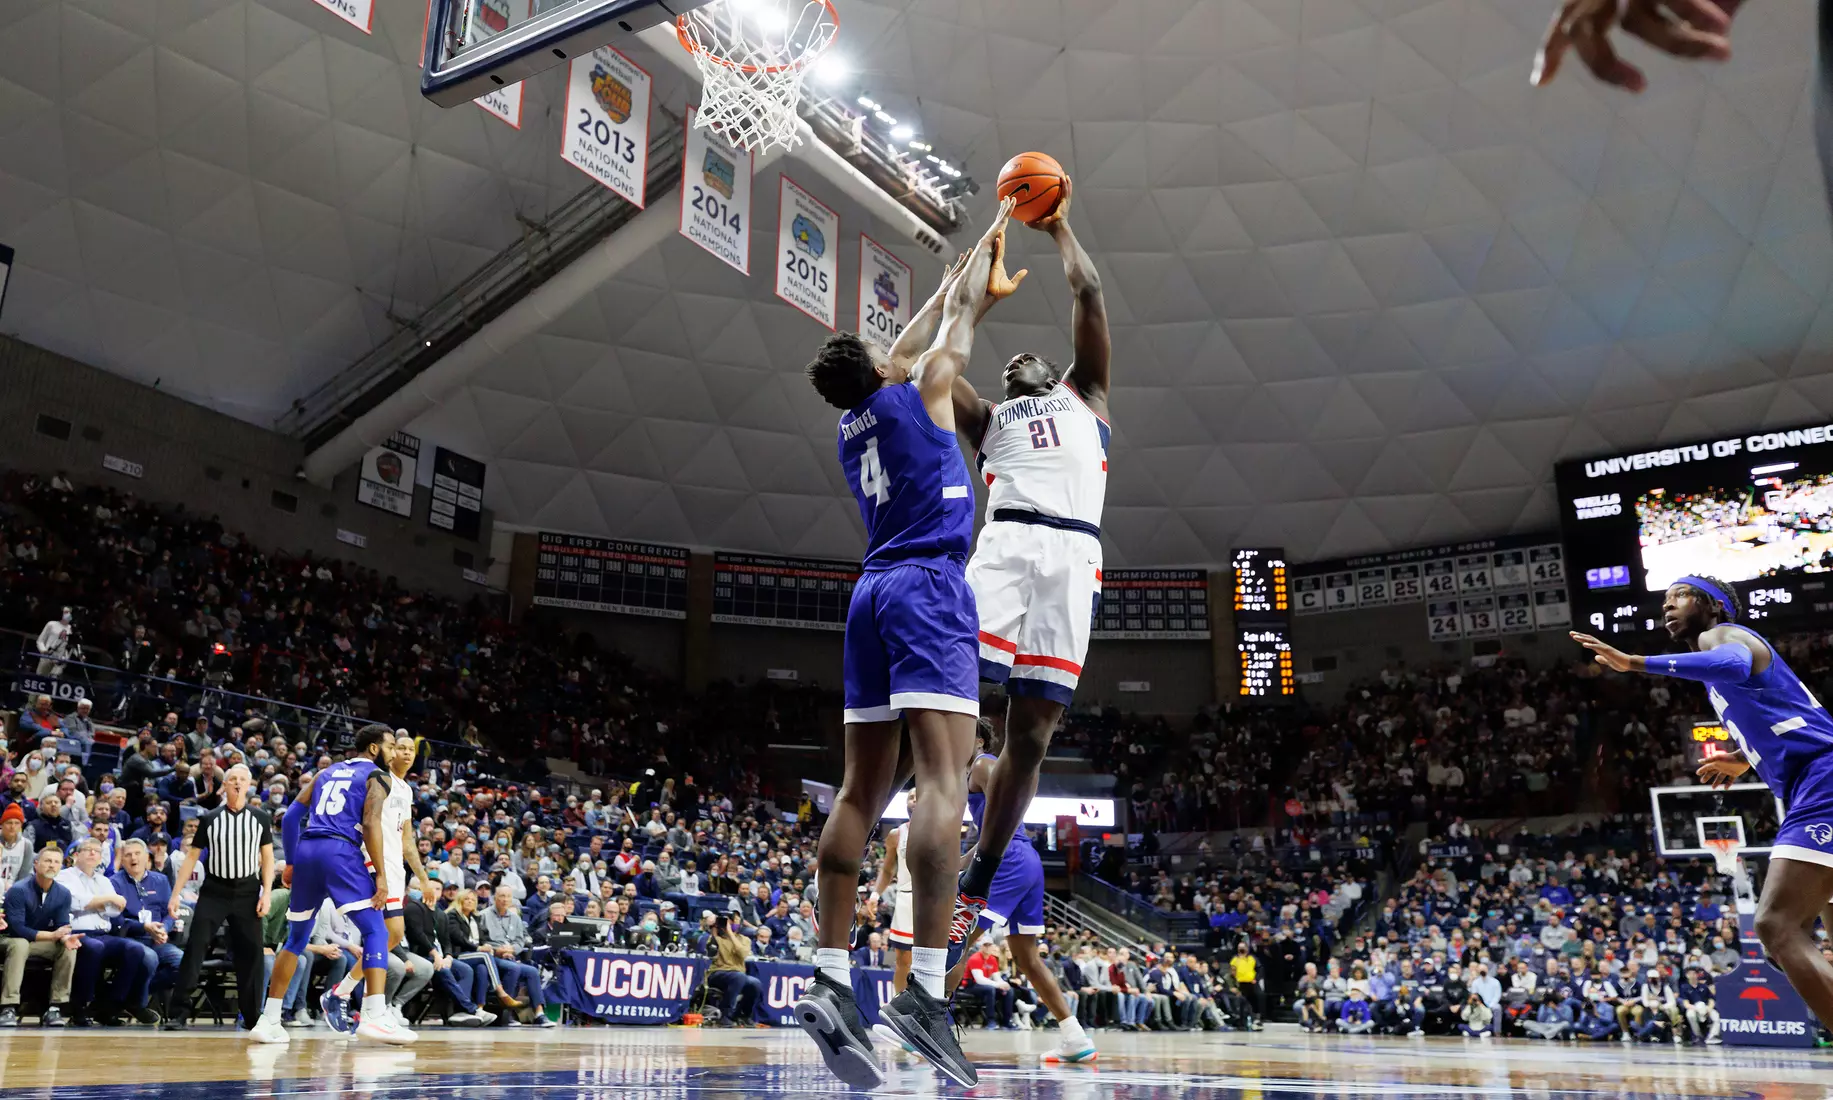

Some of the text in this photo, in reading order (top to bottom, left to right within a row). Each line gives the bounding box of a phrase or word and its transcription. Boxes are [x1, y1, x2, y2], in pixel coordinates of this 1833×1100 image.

[578, 108, 635, 164] 2013
[578, 138, 632, 180] NATIONAL
[572, 151, 634, 197] CHAMPIONS
[691, 186, 741, 235] 2014
[693, 214, 738, 249] NATIONAL
[689, 226, 741, 266] CHAMPIONS
[785, 250, 828, 293] 2015
[787, 276, 827, 307] NATIONAL
[783, 287, 830, 323] CHAMPIONS
[866, 304, 904, 339] 2016
[1028, 416, 1061, 449] 21
[1585, 443, 1709, 478] UNIVERSITY
[1712, 439, 1742, 458] OF
[122, 463, 141, 476] 210
[860, 436, 891, 506] 4
[1573, 493, 1621, 509] WELLS
[542, 534, 686, 558] BIG EAST CONFERENCE
[728, 565, 848, 579] TOURNAMENT CHAMPIONS
[1105, 571, 1198, 580] CHAMPIONSHIP
[1463, 571, 1487, 587] 44
[1535, 563, 1561, 579] 42
[1362, 583, 1384, 600] 22
[1394, 579, 1419, 596] 25
[1429, 576, 1453, 592] 42
[1302, 593, 1316, 607] C
[1336, 589, 1345, 603] 9
[1749, 588, 1792, 606] 12:46
[537, 598, 596, 609] CONNECTICUT
[629, 608, 682, 617] BASKETBALL
[715, 615, 772, 625] CONNECTICUT
[1433, 617, 1457, 633] 24
[1471, 614, 1490, 629] 13
[1504, 610, 1528, 626] 22
[1590, 612, 1605, 631] 9
[24, 679, 86, 700] SEC 109
[1693, 727, 1729, 742] 12:46
[315, 781, 352, 816] 15
[584, 957, 694, 1000] UCONN
[596, 1004, 671, 1017] BASKETBALL
[1719, 1018, 1806, 1035] TRAVELERS
